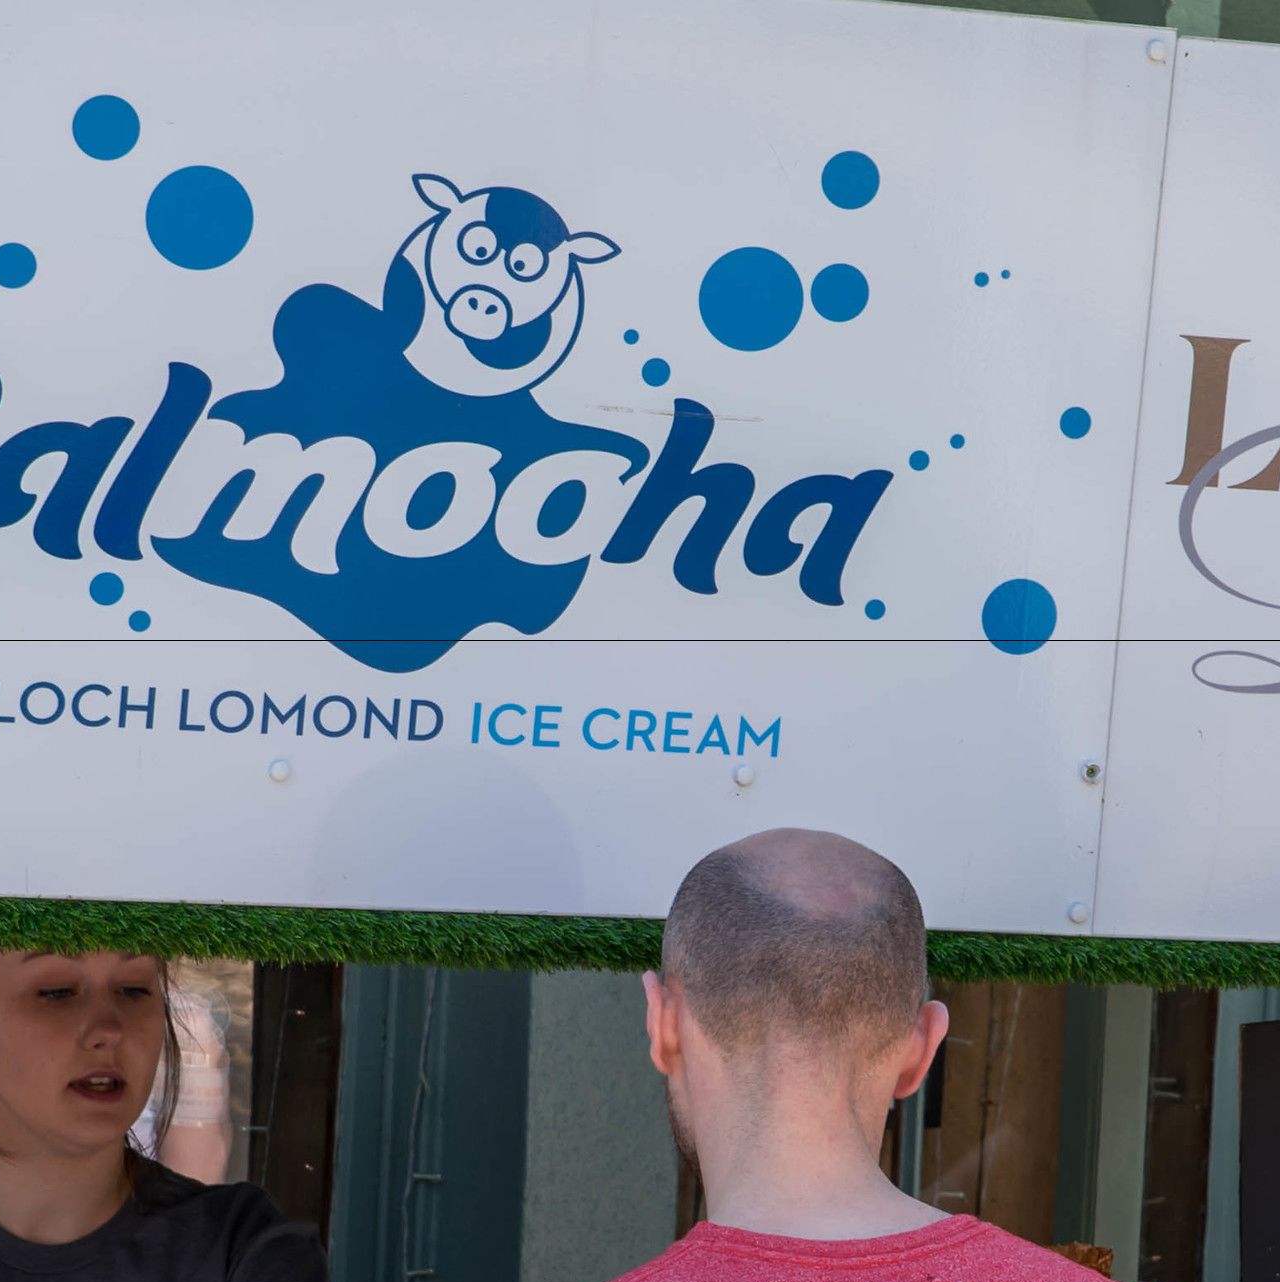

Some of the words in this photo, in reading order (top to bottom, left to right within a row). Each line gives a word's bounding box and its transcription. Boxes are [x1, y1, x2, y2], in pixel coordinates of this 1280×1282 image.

[178, 689, 444, 742] LOMOND
[470, 701, 562, 748] ICE
[582, 706, 782, 758] CREAM
